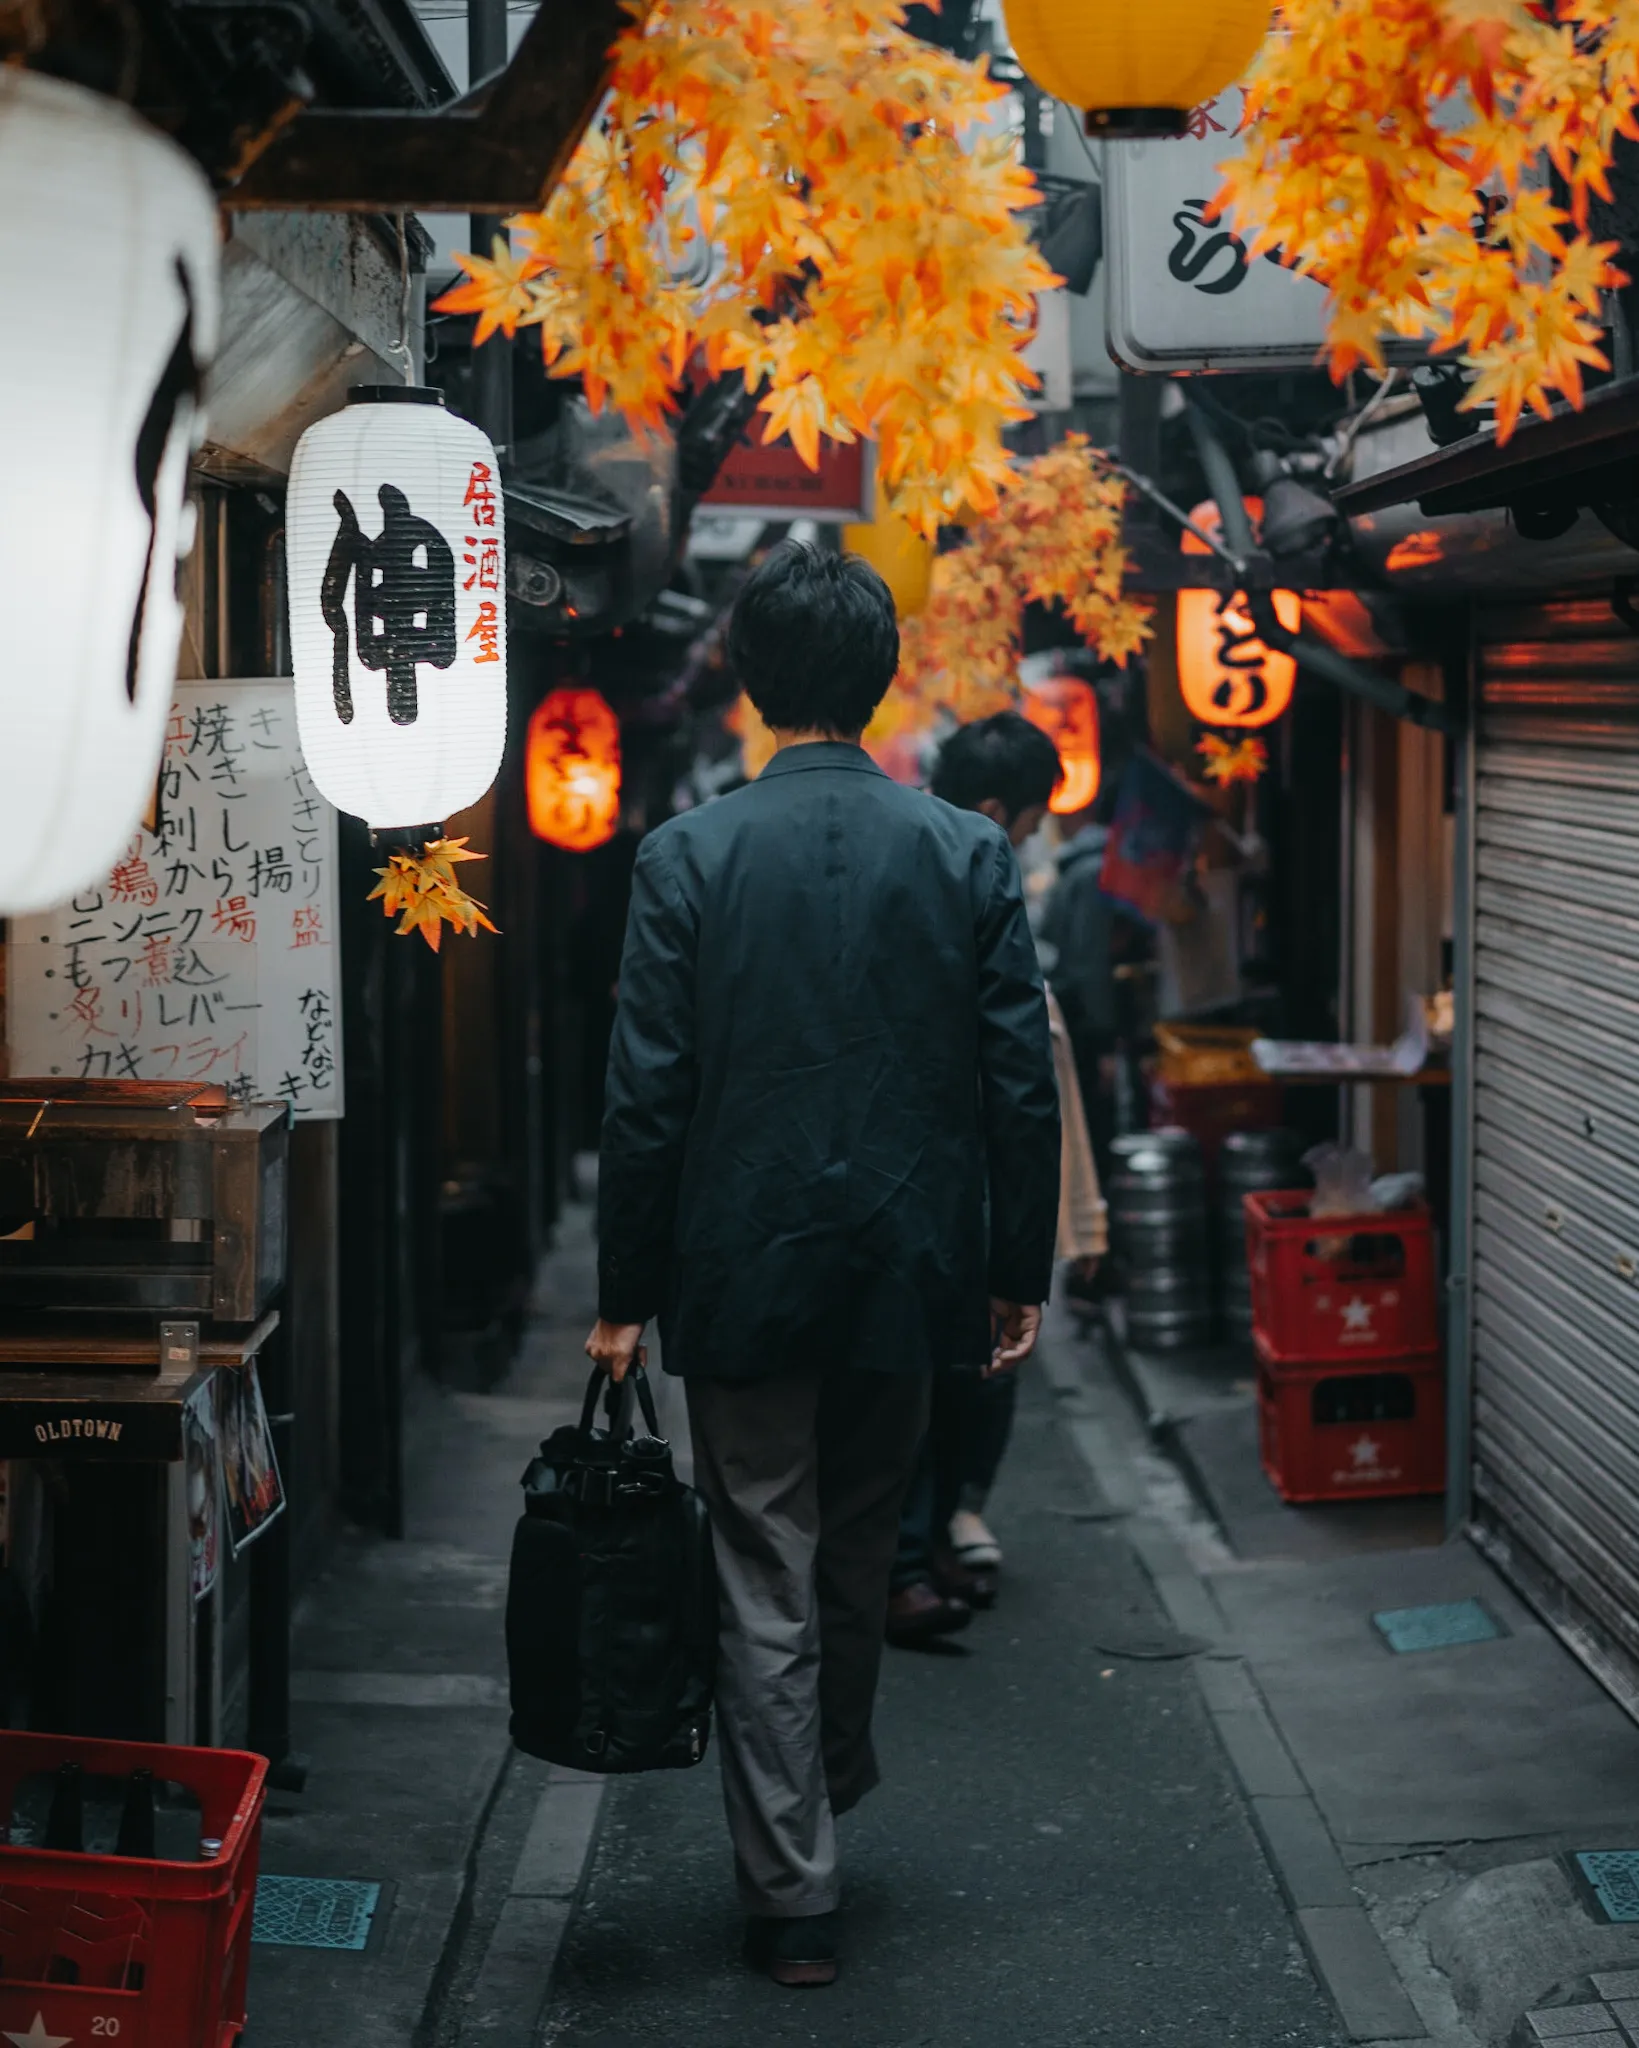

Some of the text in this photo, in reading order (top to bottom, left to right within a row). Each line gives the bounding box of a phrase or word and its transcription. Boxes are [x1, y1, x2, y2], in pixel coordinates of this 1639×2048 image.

[463, 461, 501, 664] 居酒屋
[298, 988, 335, 1090] などなど
[34, 1418, 123, 1442] OLDTOWN
[90, 2016, 120, 2037] 20
